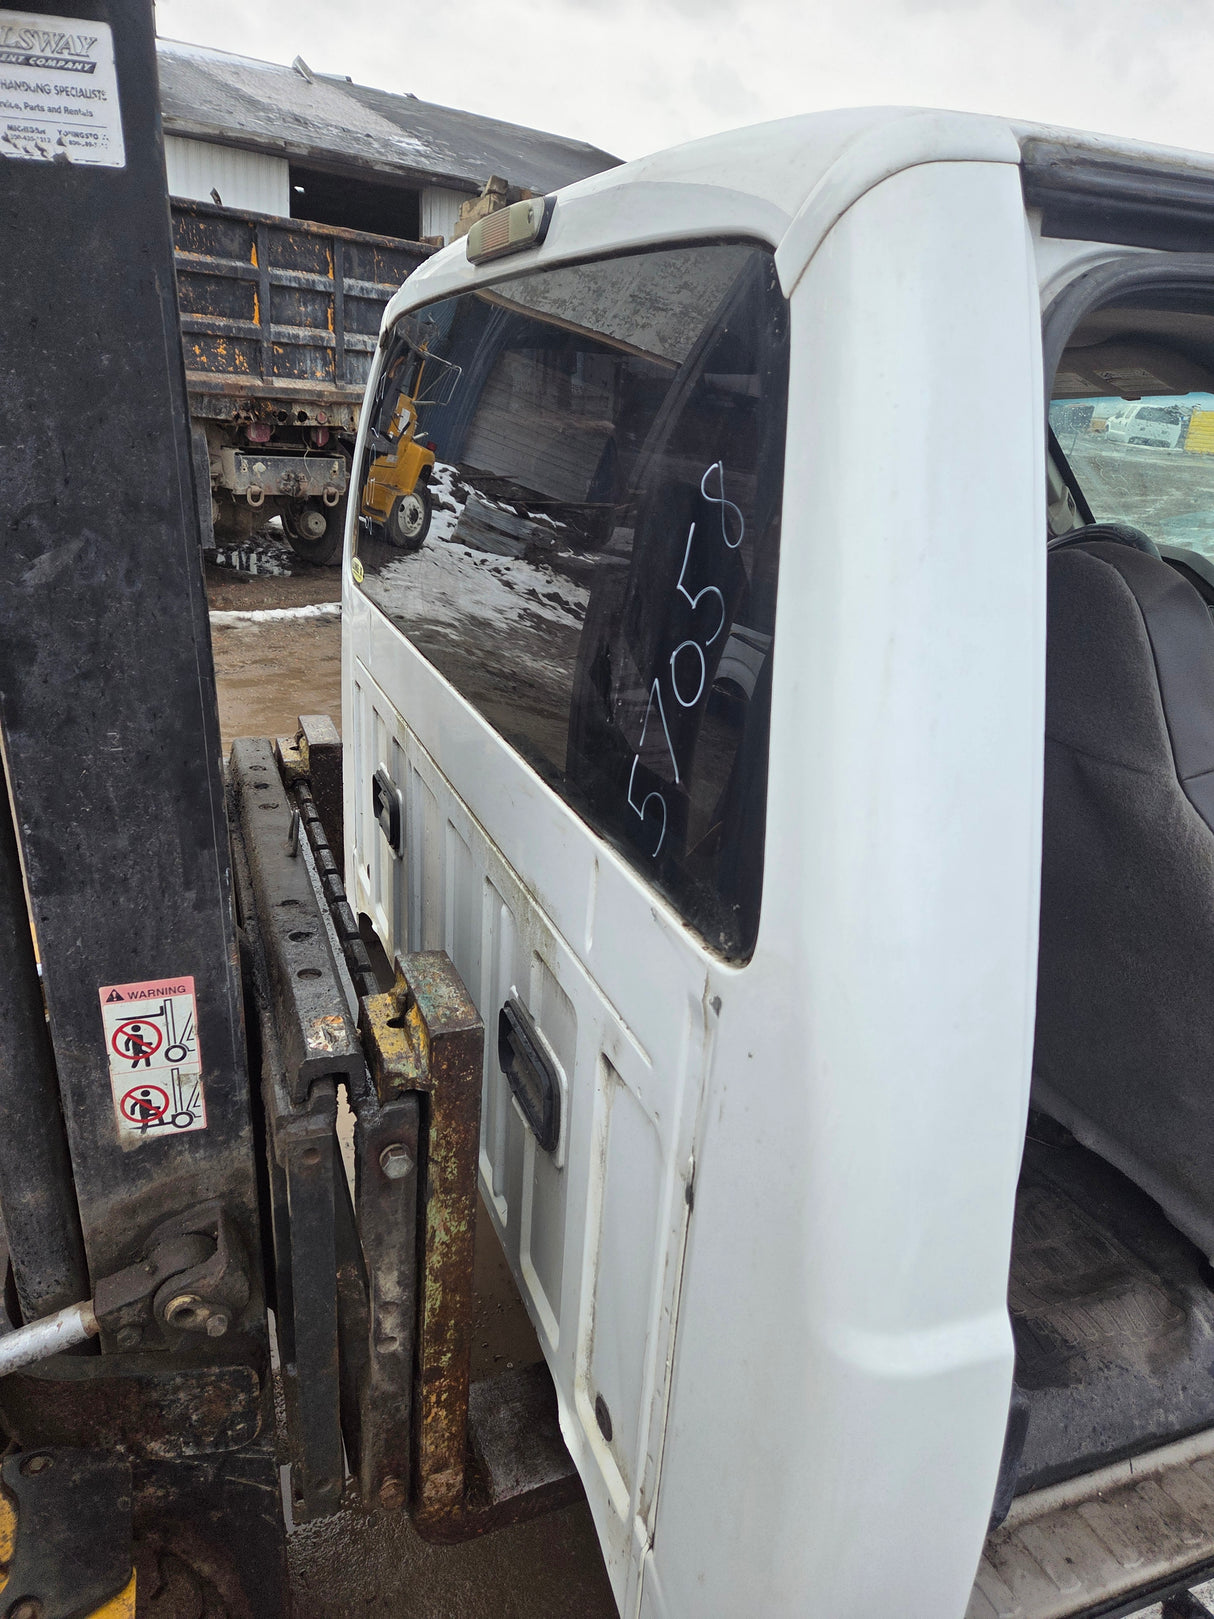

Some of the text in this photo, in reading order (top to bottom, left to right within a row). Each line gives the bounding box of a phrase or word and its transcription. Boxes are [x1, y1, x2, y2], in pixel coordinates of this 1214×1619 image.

[28, 57, 92, 71] COMPANY
[0, 79, 51, 95] HANDLING
[24, 101, 45, 113] Parts
[47, 105, 61, 114] and
[63, 106, 94, 118] Rentals
[127, 985, 187, 1000] WARNING
